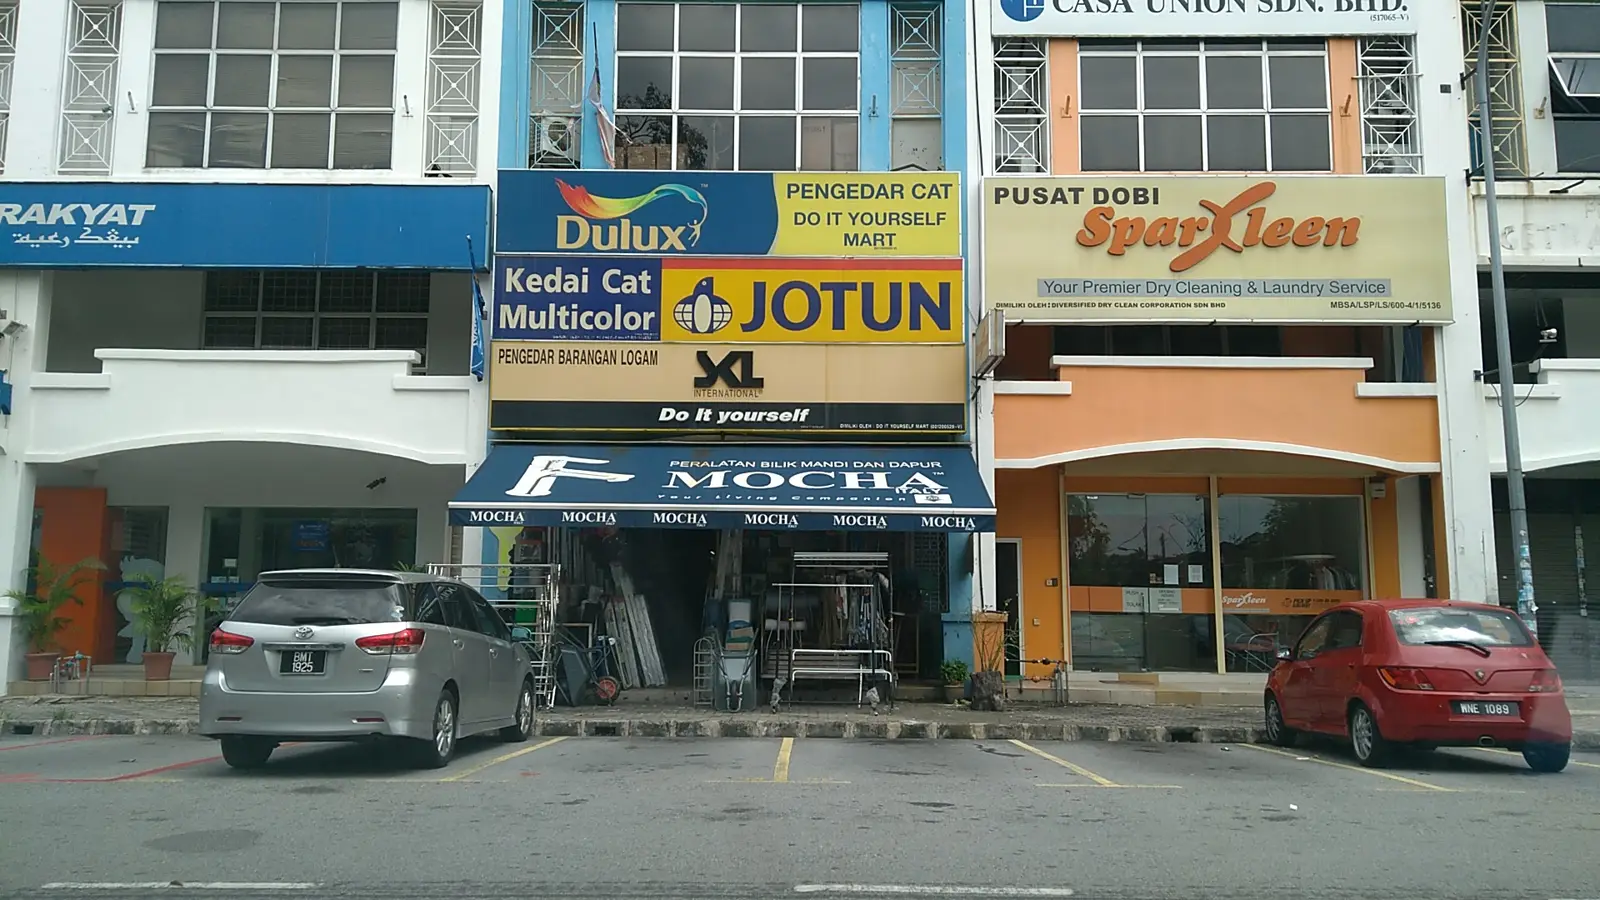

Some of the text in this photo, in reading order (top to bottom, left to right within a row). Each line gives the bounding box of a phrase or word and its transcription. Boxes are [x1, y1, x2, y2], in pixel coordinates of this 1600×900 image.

[786, 182, 953, 200] PENGEDAR CAT
[994, 187, 1159, 205] PUSAT DOBI
[0, 203, 156, 225] RAKYAT
[793, 211, 947, 226] DO IT YOURSELF
[556, 215, 687, 251] Dulux
[843, 232, 897, 247] MART
[505, 266, 651, 294] Kedai Cat
[1043, 280, 1386, 297] Your Premier Dry Cleaning & Laundry Service
[739, 279, 952, 333] JOTUN
[1330, 301, 1442, 310] MBSA/LSP/LS/600-4/1/5136
[499, 302, 656, 332] Multicolor
[498, 348, 659, 366] PENGEDAR BARANGAN LOGAM
[658, 407, 811, 426] Do It yourself
[669, 460, 756, 468] PERALATAN
[760, 461, 797, 469] BILIK
[852, 461, 885, 469] DAN
[888, 461, 942, 469] DAPUR
[661, 470, 949, 490] MOCHA
[469, 510, 525, 522] MOCHA
[561, 511, 617, 523] MOCHA
[652, 512, 707, 525] MOCHA
[744, 513, 799, 526] MOCHA
[833, 514, 888, 527] MOCHA
[920, 516, 976, 528] MOCHA
[294, 651, 313, 662] BMT
[292, 661, 313, 673] 1925
[1460, 702, 1510, 715] WNE 1089
